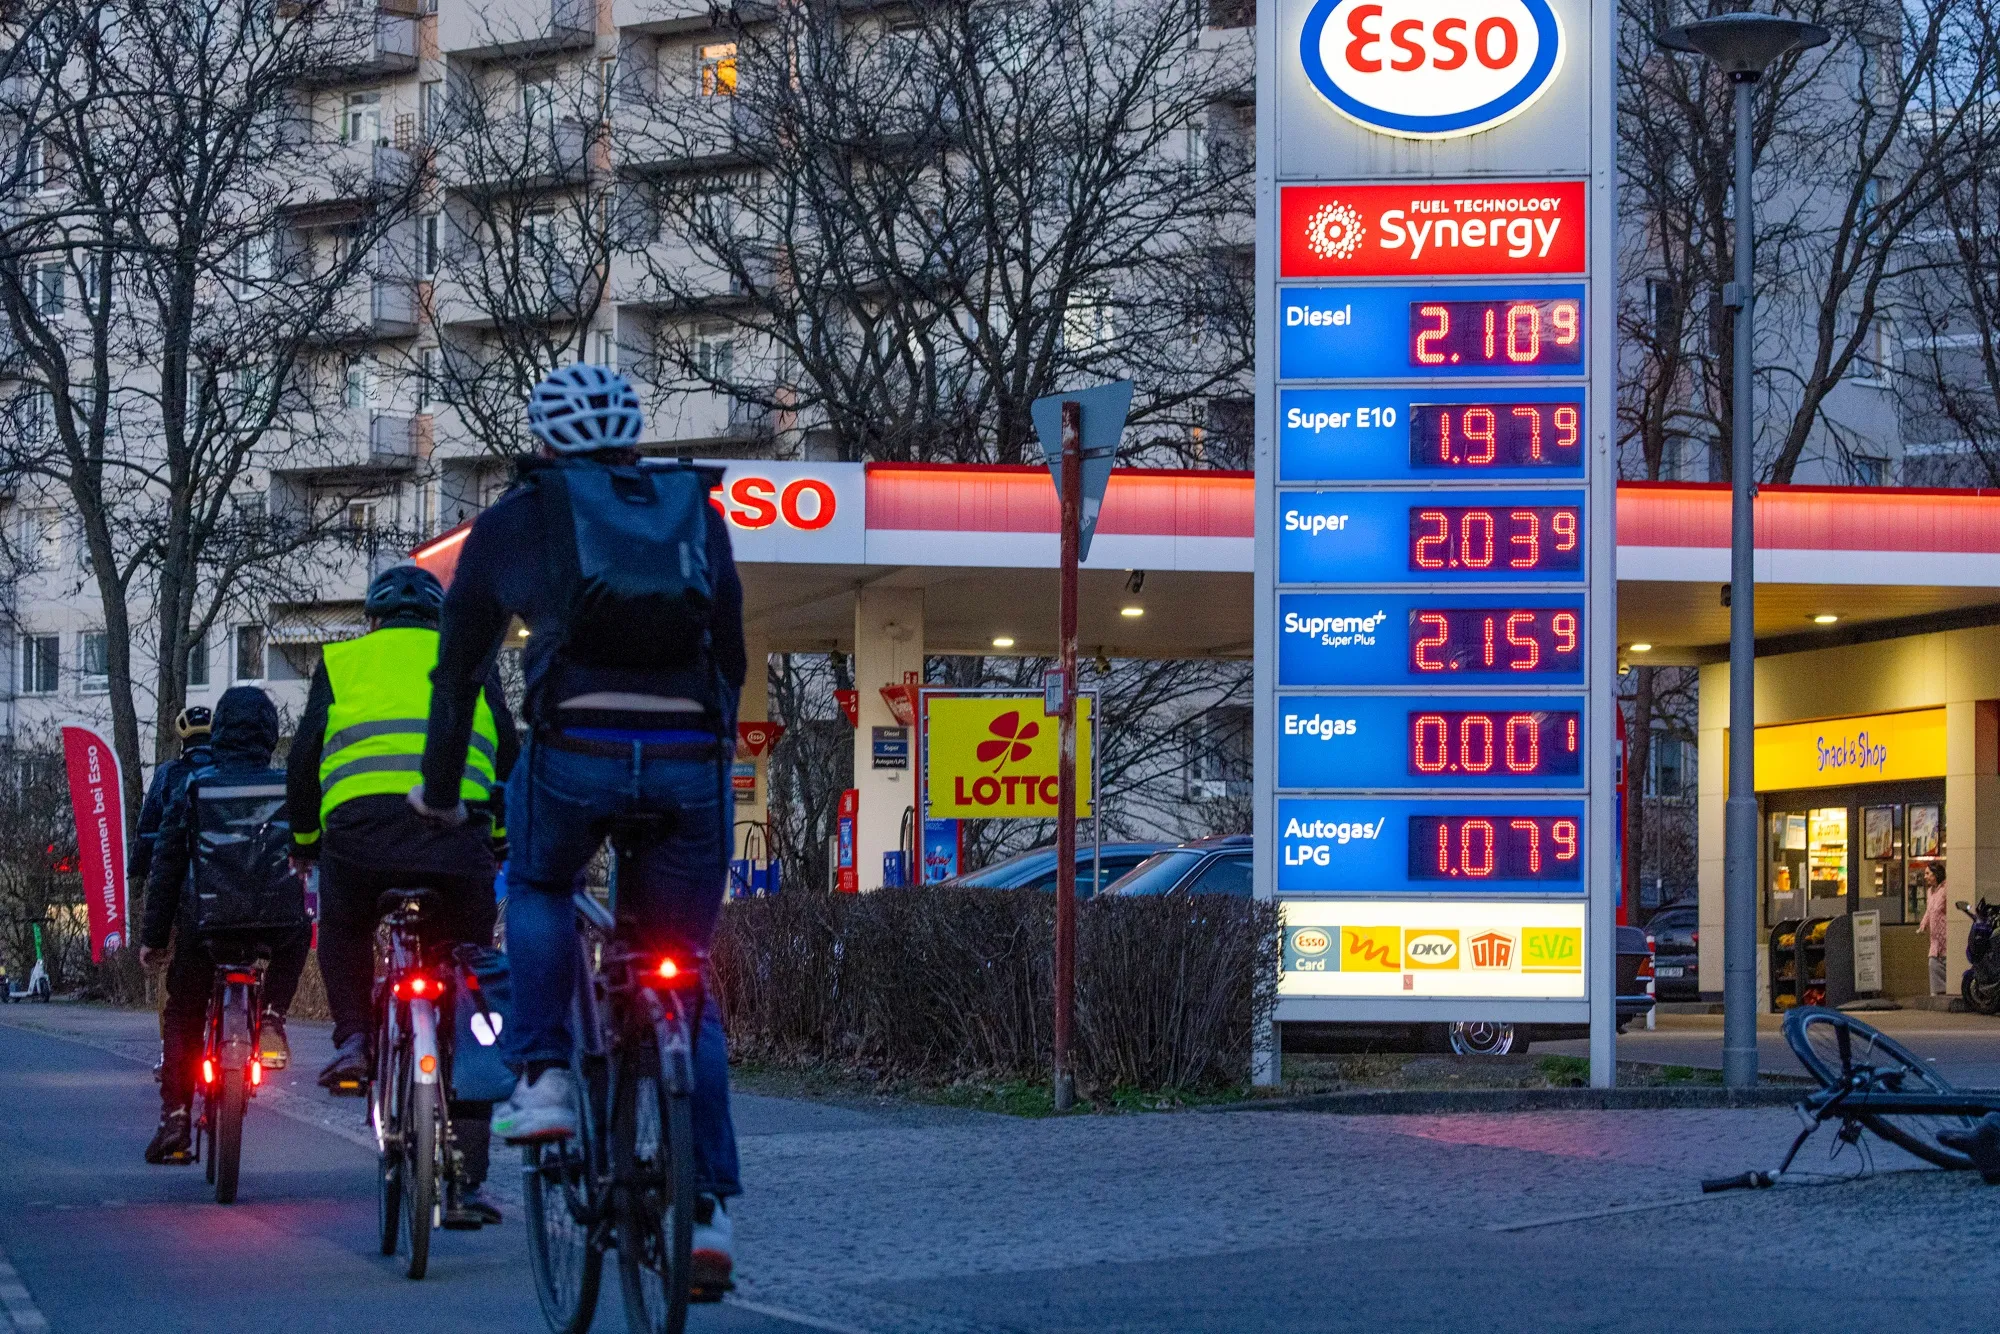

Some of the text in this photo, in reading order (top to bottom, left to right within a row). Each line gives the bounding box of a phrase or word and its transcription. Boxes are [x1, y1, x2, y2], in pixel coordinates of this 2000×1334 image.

[1345, 4, 1518, 73] Esso
[1411, 198, 1561, 213] FUEL TECHNOLOGY
[1380, 210, 1561, 260] Synergy
[1286, 304, 1351, 326] Diesel
[1287, 407, 1397, 434] Super E10
[1285, 511, 1349, 536] Super
[1321, 633, 1376, 648] Super Plus
[1284, 714, 1357, 741] Erdgas
[883, 744, 900, 752] Super
[1817, 731, 1887, 774] Snack & Shop
[87, 745, 102, 784] Esso
[91, 787, 106, 815] bei
[1284, 817, 1385, 844] Autogas/
[1284, 845, 1330, 866] LPG
[97, 817, 119, 923] Willkommen
[1298, 935, 1325, 947] Esso
[1411, 943, 1453, 956] DKV
[1471, 932, 1512, 967] UTA
[1529, 934, 1574, 960] SVG
[1295, 958, 1326, 971] Card
